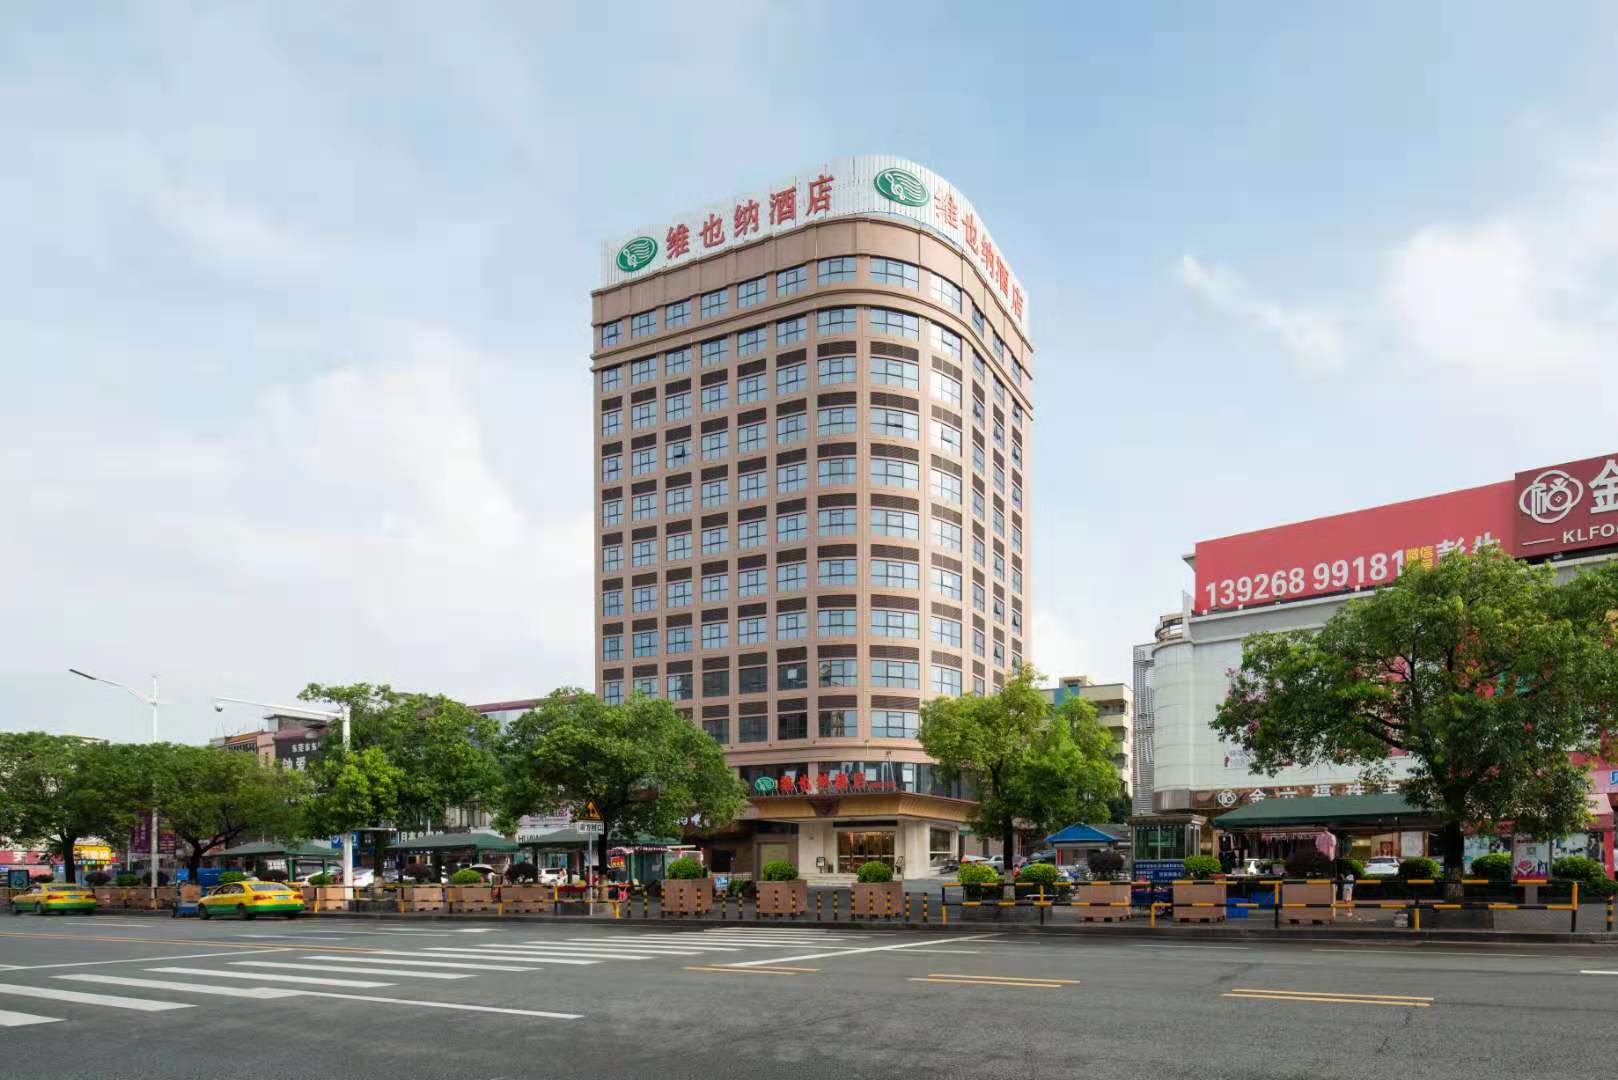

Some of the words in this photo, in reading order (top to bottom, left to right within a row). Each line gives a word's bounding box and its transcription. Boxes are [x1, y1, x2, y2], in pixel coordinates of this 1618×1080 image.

[665, 174, 834, 260] 维也纳酒店
[934, 192, 1024, 322] 维也纳酒店
[1562, 523, 1618, 544] KLFO
[1205, 567, 1305, 607] 139268
[1313, 549, 1405, 591] 99181
